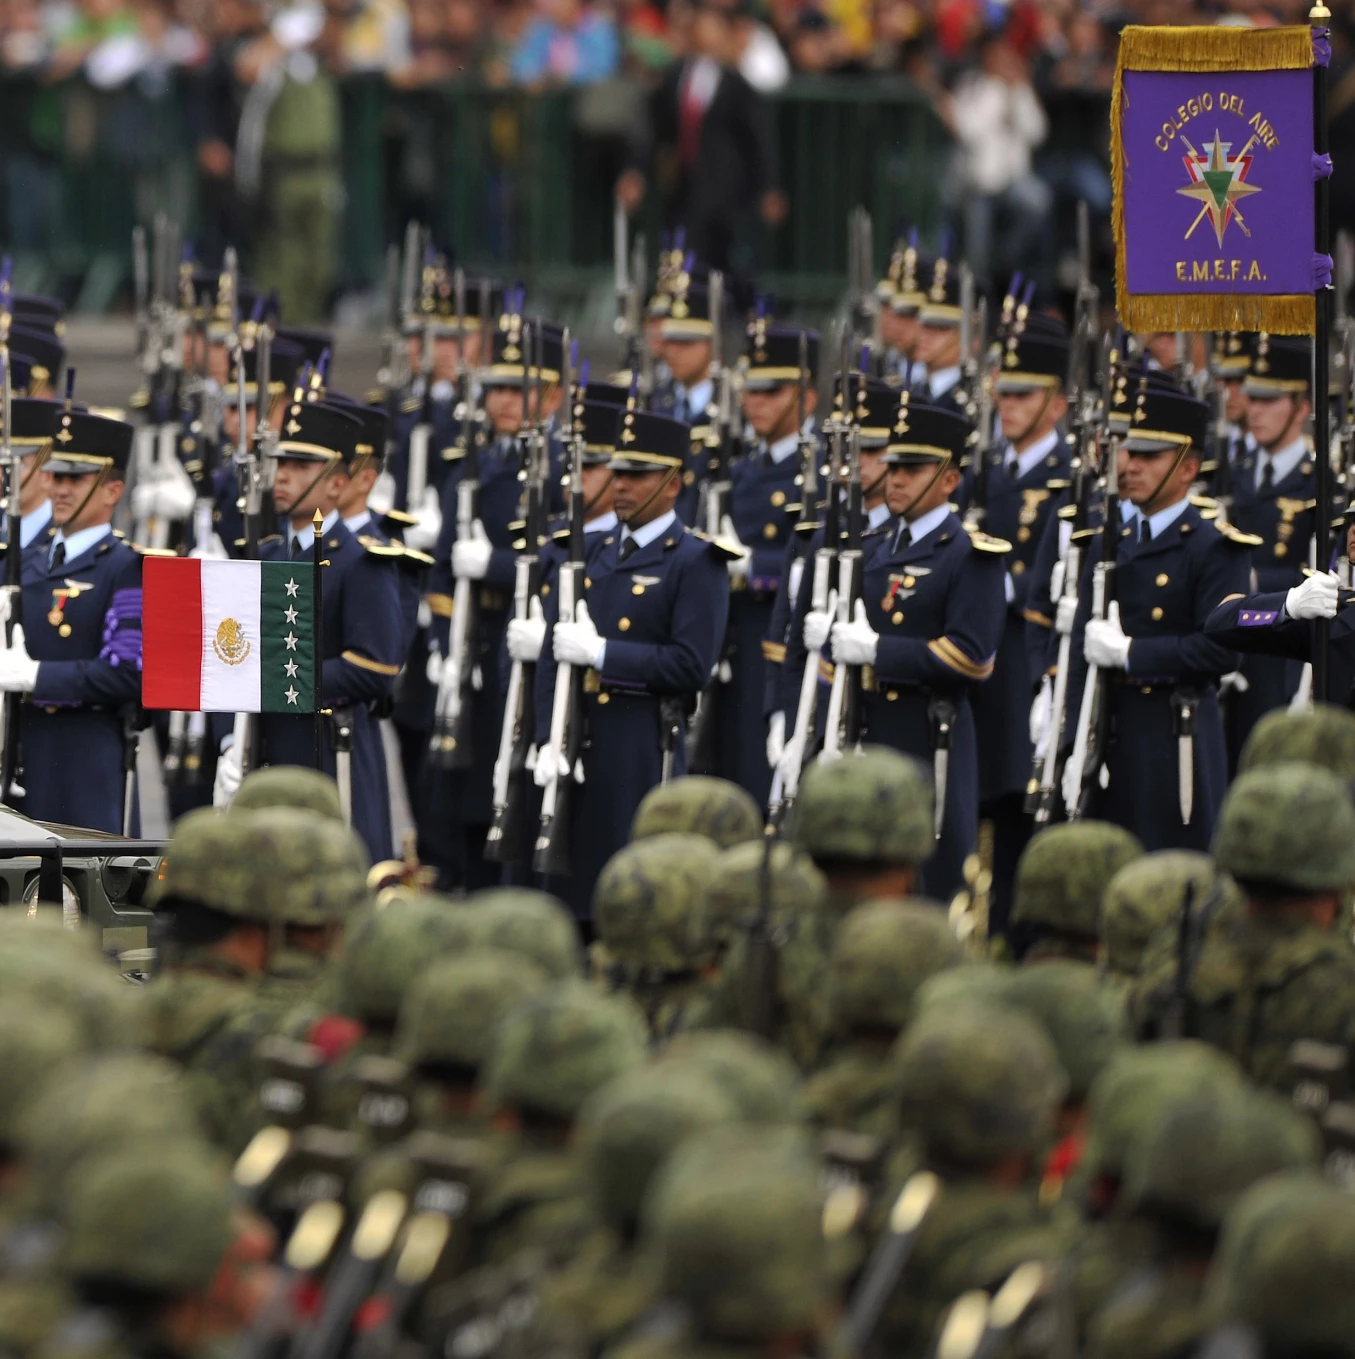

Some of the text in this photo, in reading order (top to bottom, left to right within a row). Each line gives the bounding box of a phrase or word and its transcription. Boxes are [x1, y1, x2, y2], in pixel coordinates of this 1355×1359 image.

[1155, 92, 1280, 152] COLEGIO DEL AIRE
[1176, 259, 1267, 281] E.M.E.F.A.
